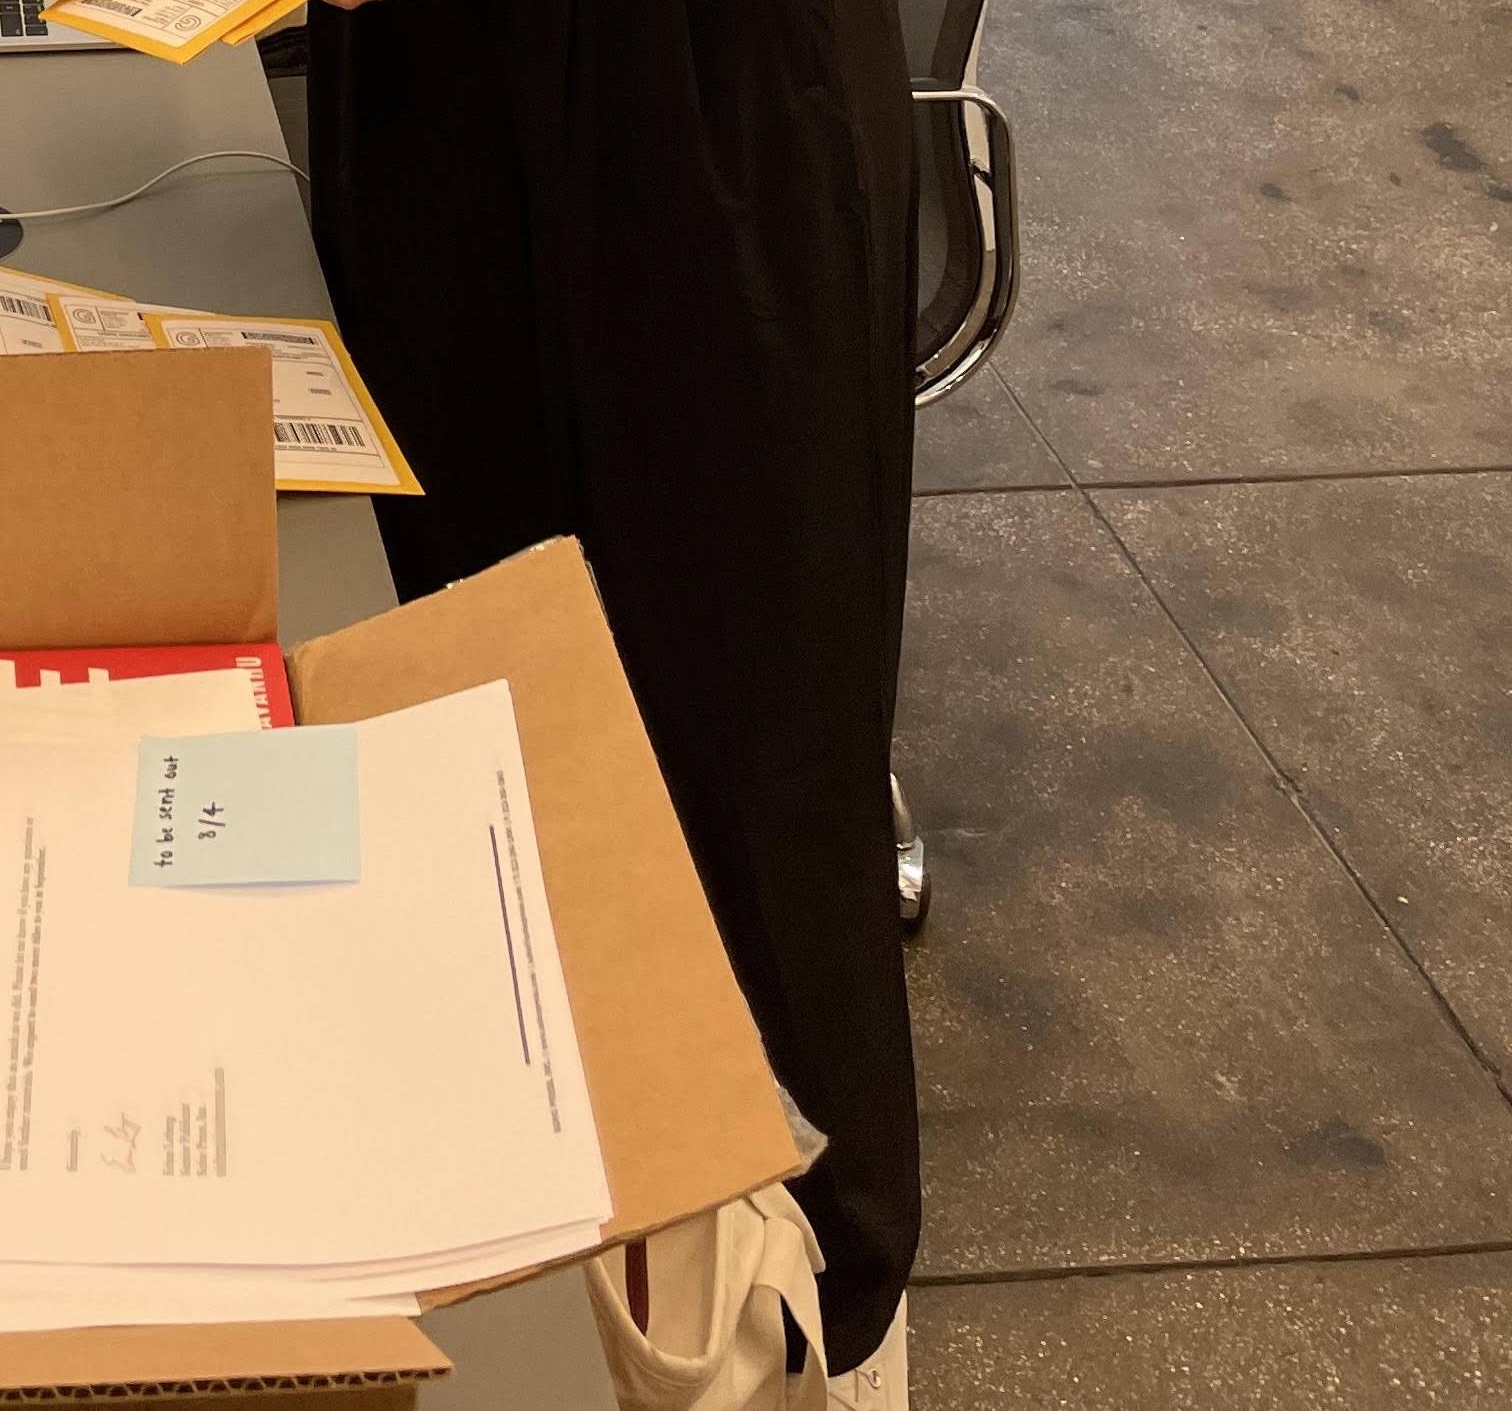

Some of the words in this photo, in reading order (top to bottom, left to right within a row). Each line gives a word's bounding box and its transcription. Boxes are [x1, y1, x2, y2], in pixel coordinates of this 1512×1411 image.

[163, 755, 179, 779] out
[158, 788, 175, 820] sent
[197, 801, 226, 840] 8/4
[155, 827, 174, 843] be
[153, 850, 174, 868] to
